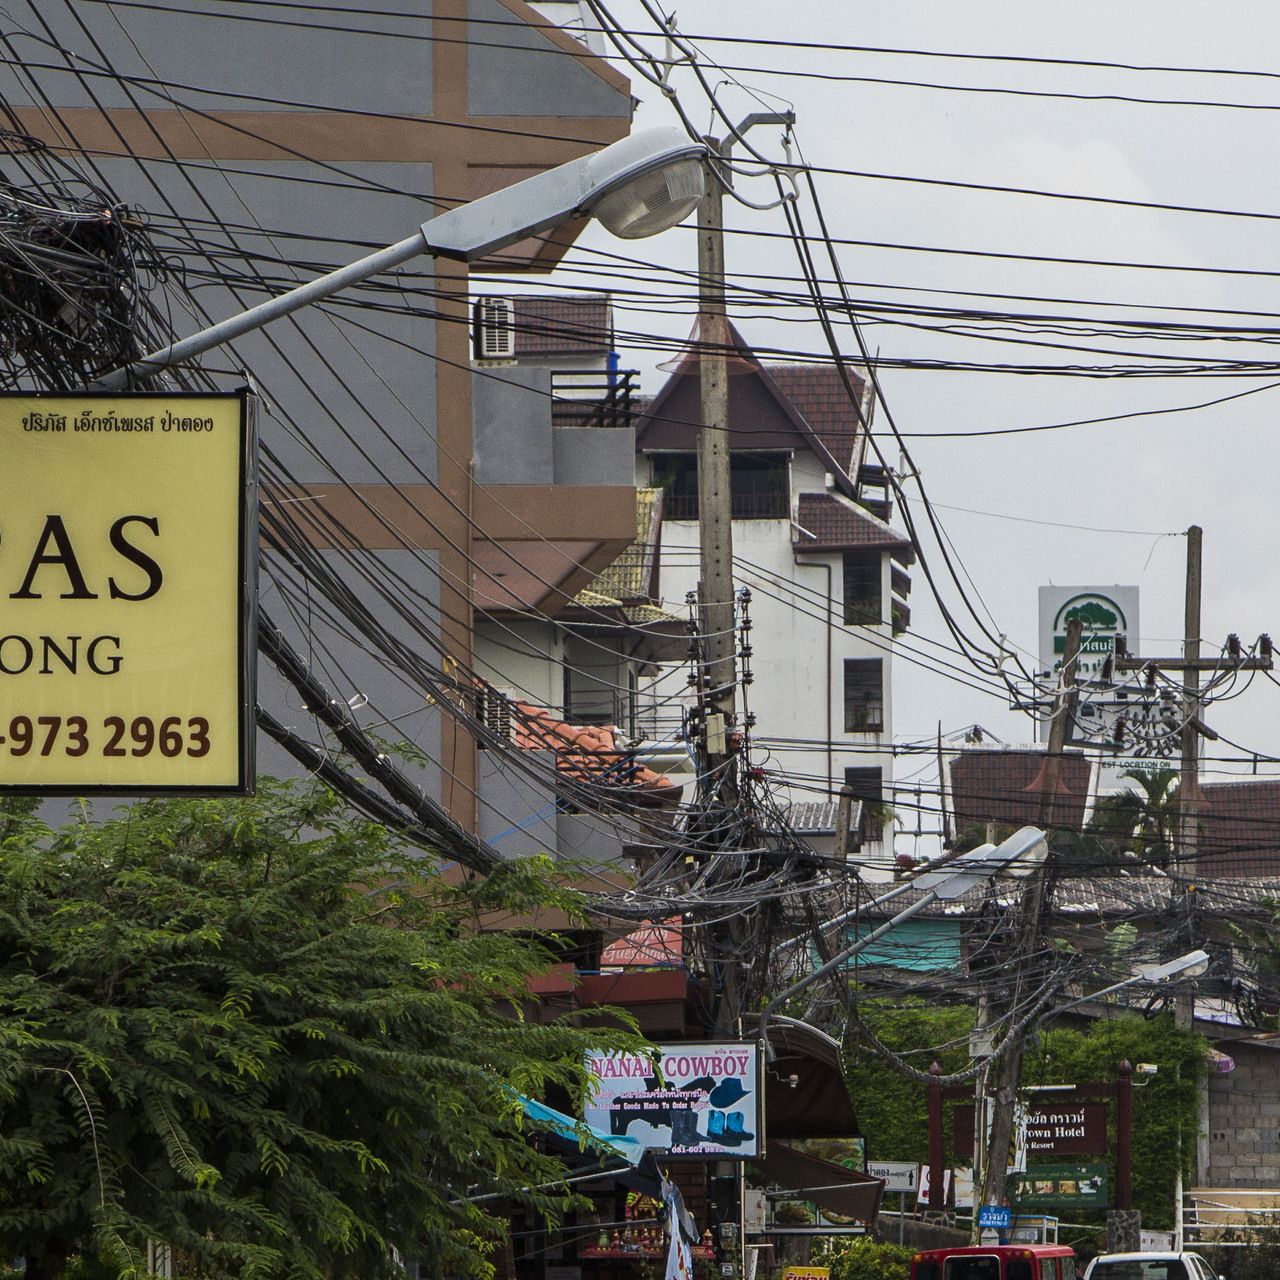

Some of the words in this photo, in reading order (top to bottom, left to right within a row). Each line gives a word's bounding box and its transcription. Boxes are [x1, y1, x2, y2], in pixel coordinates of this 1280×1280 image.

[161, 410, 214, 432] ป่าตอง
[664, 1056, 749, 1077] COWBOY
[1026, 1129, 1051, 1138] rown
[1055, 1126, 1085, 1138] Hotel
[1031, 1141, 1055, 1150] Resort
